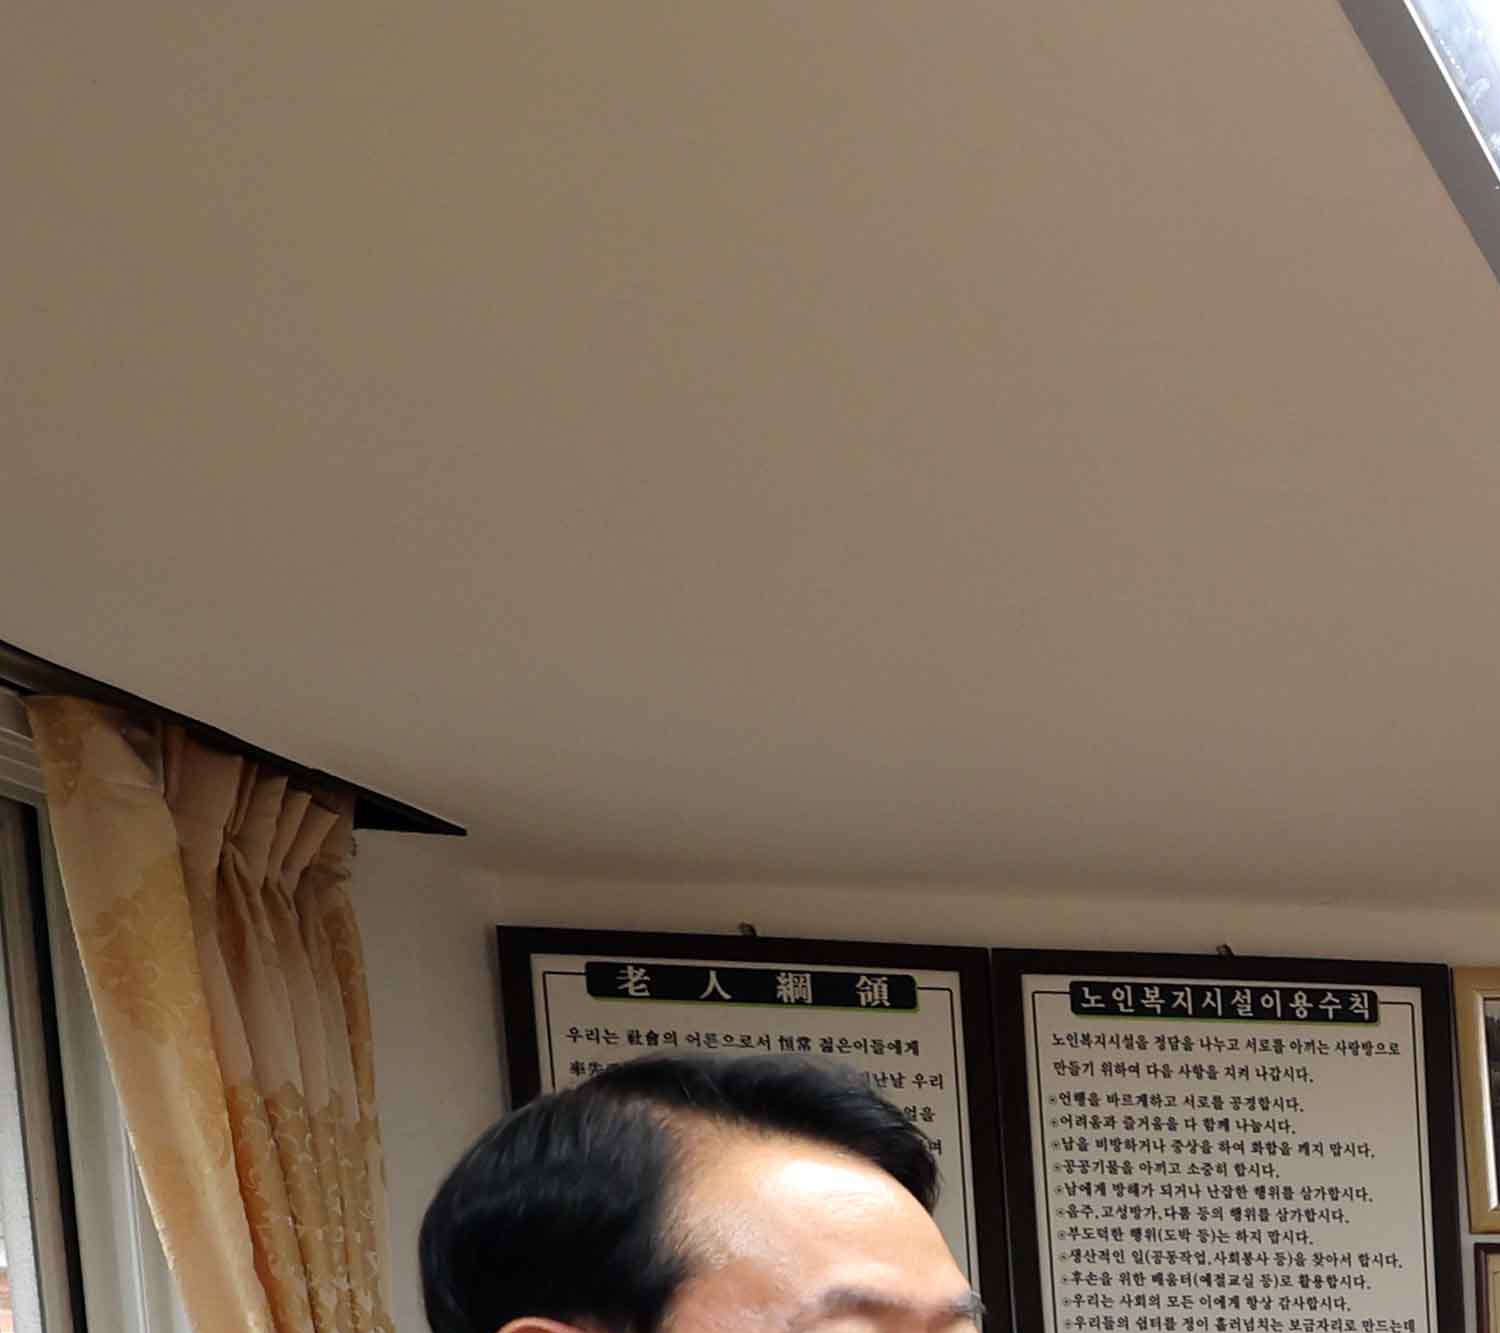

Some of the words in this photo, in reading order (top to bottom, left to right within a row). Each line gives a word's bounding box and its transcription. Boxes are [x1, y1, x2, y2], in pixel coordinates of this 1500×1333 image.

[615, 964, 891, 1009] 老人綱領
[1078, 983, 1372, 1021] 노인복지시설이용수칙
[566, 1026, 620, 1045] 우리는
[685, 1031, 772, 1052] 어른으로서
[819, 1036, 920, 1057] 젊은이들에게
[1051, 1031, 1150, 1050] 노인복지시설을
[1199, 1035, 1241, 1053] 나누고
[1245, 1037, 1286, 1055] 서로를
[1289, 1038, 1330, 1056] 아끼는
[1335, 1039, 1401, 1057] 사랑방으로
[1052, 1058, 1095, 1077] 만들기
[1100, 1061, 1141, 1079] 위하여
[1145, 1062, 1174, 1079] 다음
[1177, 1063, 1219, 1081] 사항을
[1223, 1064, 1250, 1081] 지켜
[864, 1070, 905, 1090] 난날
[911, 1072, 944, 1091] 우리
[1105, 1091, 1177, 1109] 바르게하고
[1183, 1093, 1225, 1111] 서로를
[1059, 1113, 1118, 1131] 어려움과
[1183, 1116, 1198, 1132] 다
[1061, 1136, 1089, 1153] 남을
[1095, 1136, 1167, 1154] 비방하거나
[1170, 1138, 1213, 1155] 중상을
[1217, 1139, 1245, 1156] 하여
[1138, 1160, 1182, 1176] 아끼고
[1186, 1161, 1228, 1177] 소중히
[1071, 1292, 1114, 1309] 우리는
[1166, 1294, 1195, 1310] 모든
